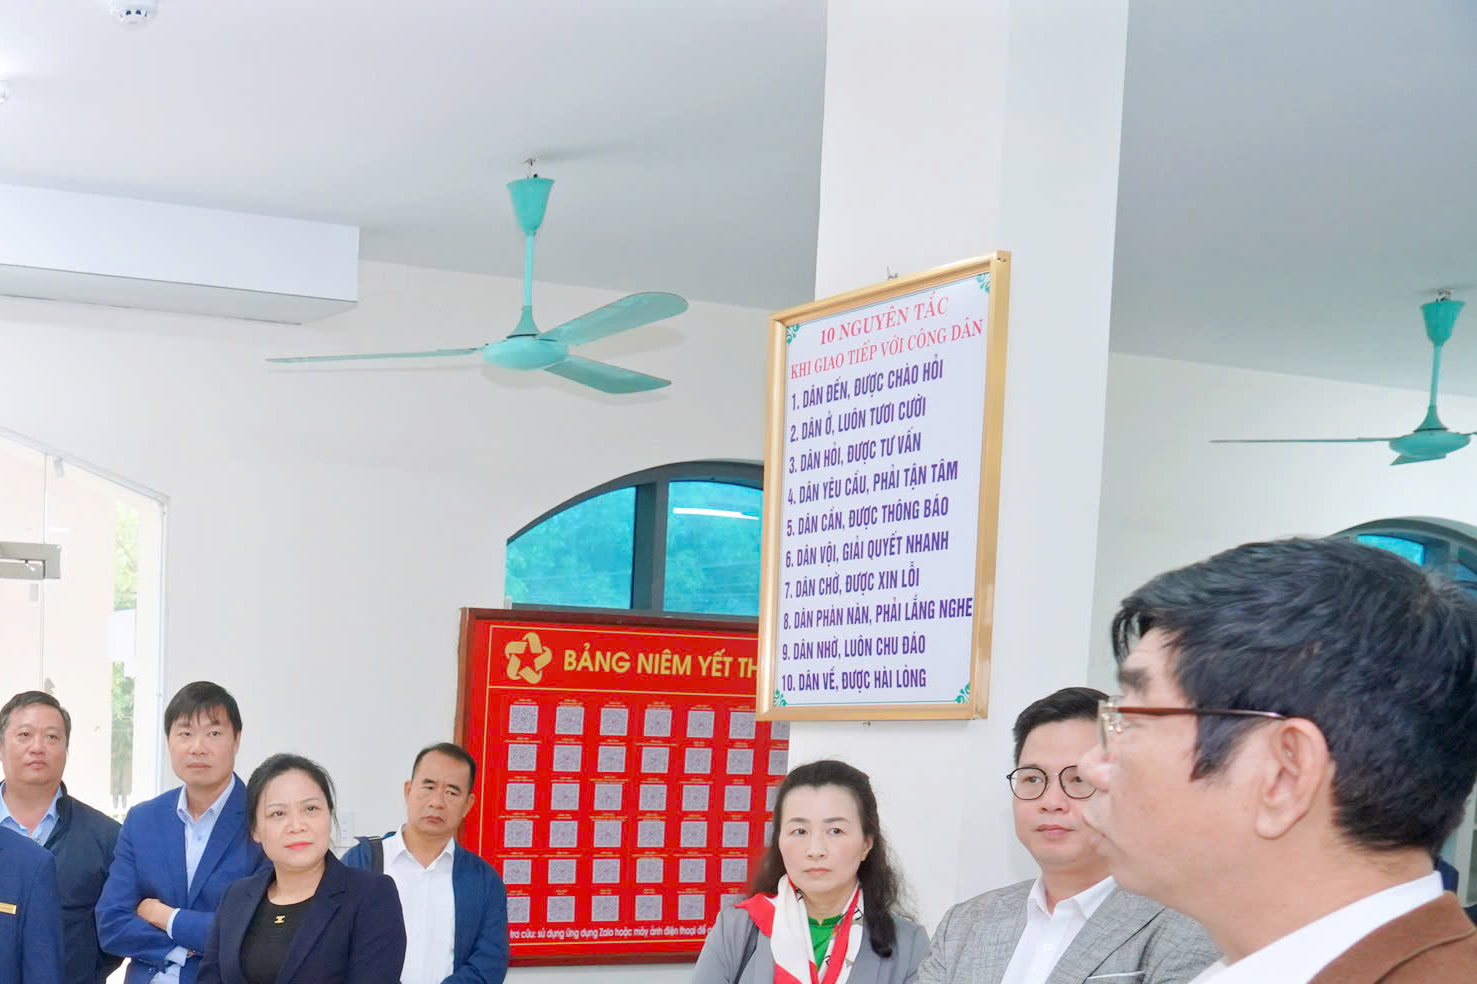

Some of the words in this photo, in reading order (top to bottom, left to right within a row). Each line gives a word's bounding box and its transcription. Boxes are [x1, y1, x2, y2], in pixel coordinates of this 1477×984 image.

[820, 328, 835, 345] 10
[839, 305, 909, 340] NGUYÊN
[913, 290, 949, 321] TẮC
[790, 360, 812, 380] KHI
[814, 352, 845, 374] GIAO
[847, 339, 878, 365] TIẾP
[881, 334, 903, 357] VỚI
[907, 327, 947, 351] CÔNG
[951, 317, 984, 341] DÂN
[792, 393, 800, 411] 1.
[803, 384, 823, 409] DÂN
[826, 376, 850, 403] ĐẾN,
[854, 372, 884, 398] ĐƯỢC
[887, 363, 919, 390] CHÀO
[922, 353, 943, 382] HỎI
[790, 424, 799, 443] 2.
[801, 417, 822, 440] DÂN
[825, 410, 835, 436] Ở,
[838, 407, 866, 433] LUÔN
[870, 402, 895, 426] TƯƠI
[898, 393, 926, 420] CƯỜI
[789, 456, 797, 474] 3.
[800, 449, 821, 472] DÂN
[824, 441, 844, 468] HỎI,
[847, 439, 876, 464] ĐƯỢC
[880, 435, 896, 457] TƯ
[898, 426, 921, 455] VẤN
[788, 488, 796, 505] 4.
[799, 480, 819, 504] DÂN
[822, 476, 842, 500] YÊU
[873, 464, 900, 492] PHẢI
[904, 462, 927, 490] TẬN
[931, 458, 958, 483] TÂM
[787, 519, 795, 537] 5.
[798, 512, 818, 535] DÂN
[849, 505, 878, 530] ĐƯỢC
[882, 498, 920, 523] THÔNG
[923, 493, 949, 518] BÁO
[785, 551, 794, 568] 6.
[797, 544, 817, 567] DÂN
[820, 541, 839, 567] VỘI,
[843, 535, 864, 561] GIẢI
[867, 530, 903, 560] QUYẾT
[906, 531, 949, 554] NHANH
[785, 582, 793, 599] 7.
[796, 575, 815, 598] DÂN
[819, 571, 842, 596] CHỜ,
[846, 571, 874, 596] ĐƯỢC
[878, 570, 898, 590] XIN
[901, 561, 919, 588] LỖI
[783, 612, 791, 630] 8.
[794, 607, 813, 629] DÂN
[816, 604, 843, 627] PHÀN
[847, 602, 872, 626] NÀN,
[876, 597, 901, 623] PHẢI
[905, 594, 935, 621] LẮNG
[939, 597, 973, 618] NGHE
[563, 642, 631, 674] BẢNG
[637, 648, 693, 676] NIÊM
[698, 648, 732, 677] YẾT
[738, 657, 758, 678] TH
[782, 643, 790, 660] 9.
[793, 639, 813, 660] DÂN
[817, 635, 841, 659] NHỜ,
[845, 634, 872, 657] LUÔN
[876, 636, 898, 656] CHU
[902, 631, 925, 654] ĐÁO
[782, 674, 795, 691] 10.
[799, 669, 819, 691] DÂN
[822, 666, 839, 692] VỀ,
[842, 669, 870, 693] ĐƯỢC
[874, 666, 892, 689] HÀI
[896, 664, 926, 688] LÒNG
